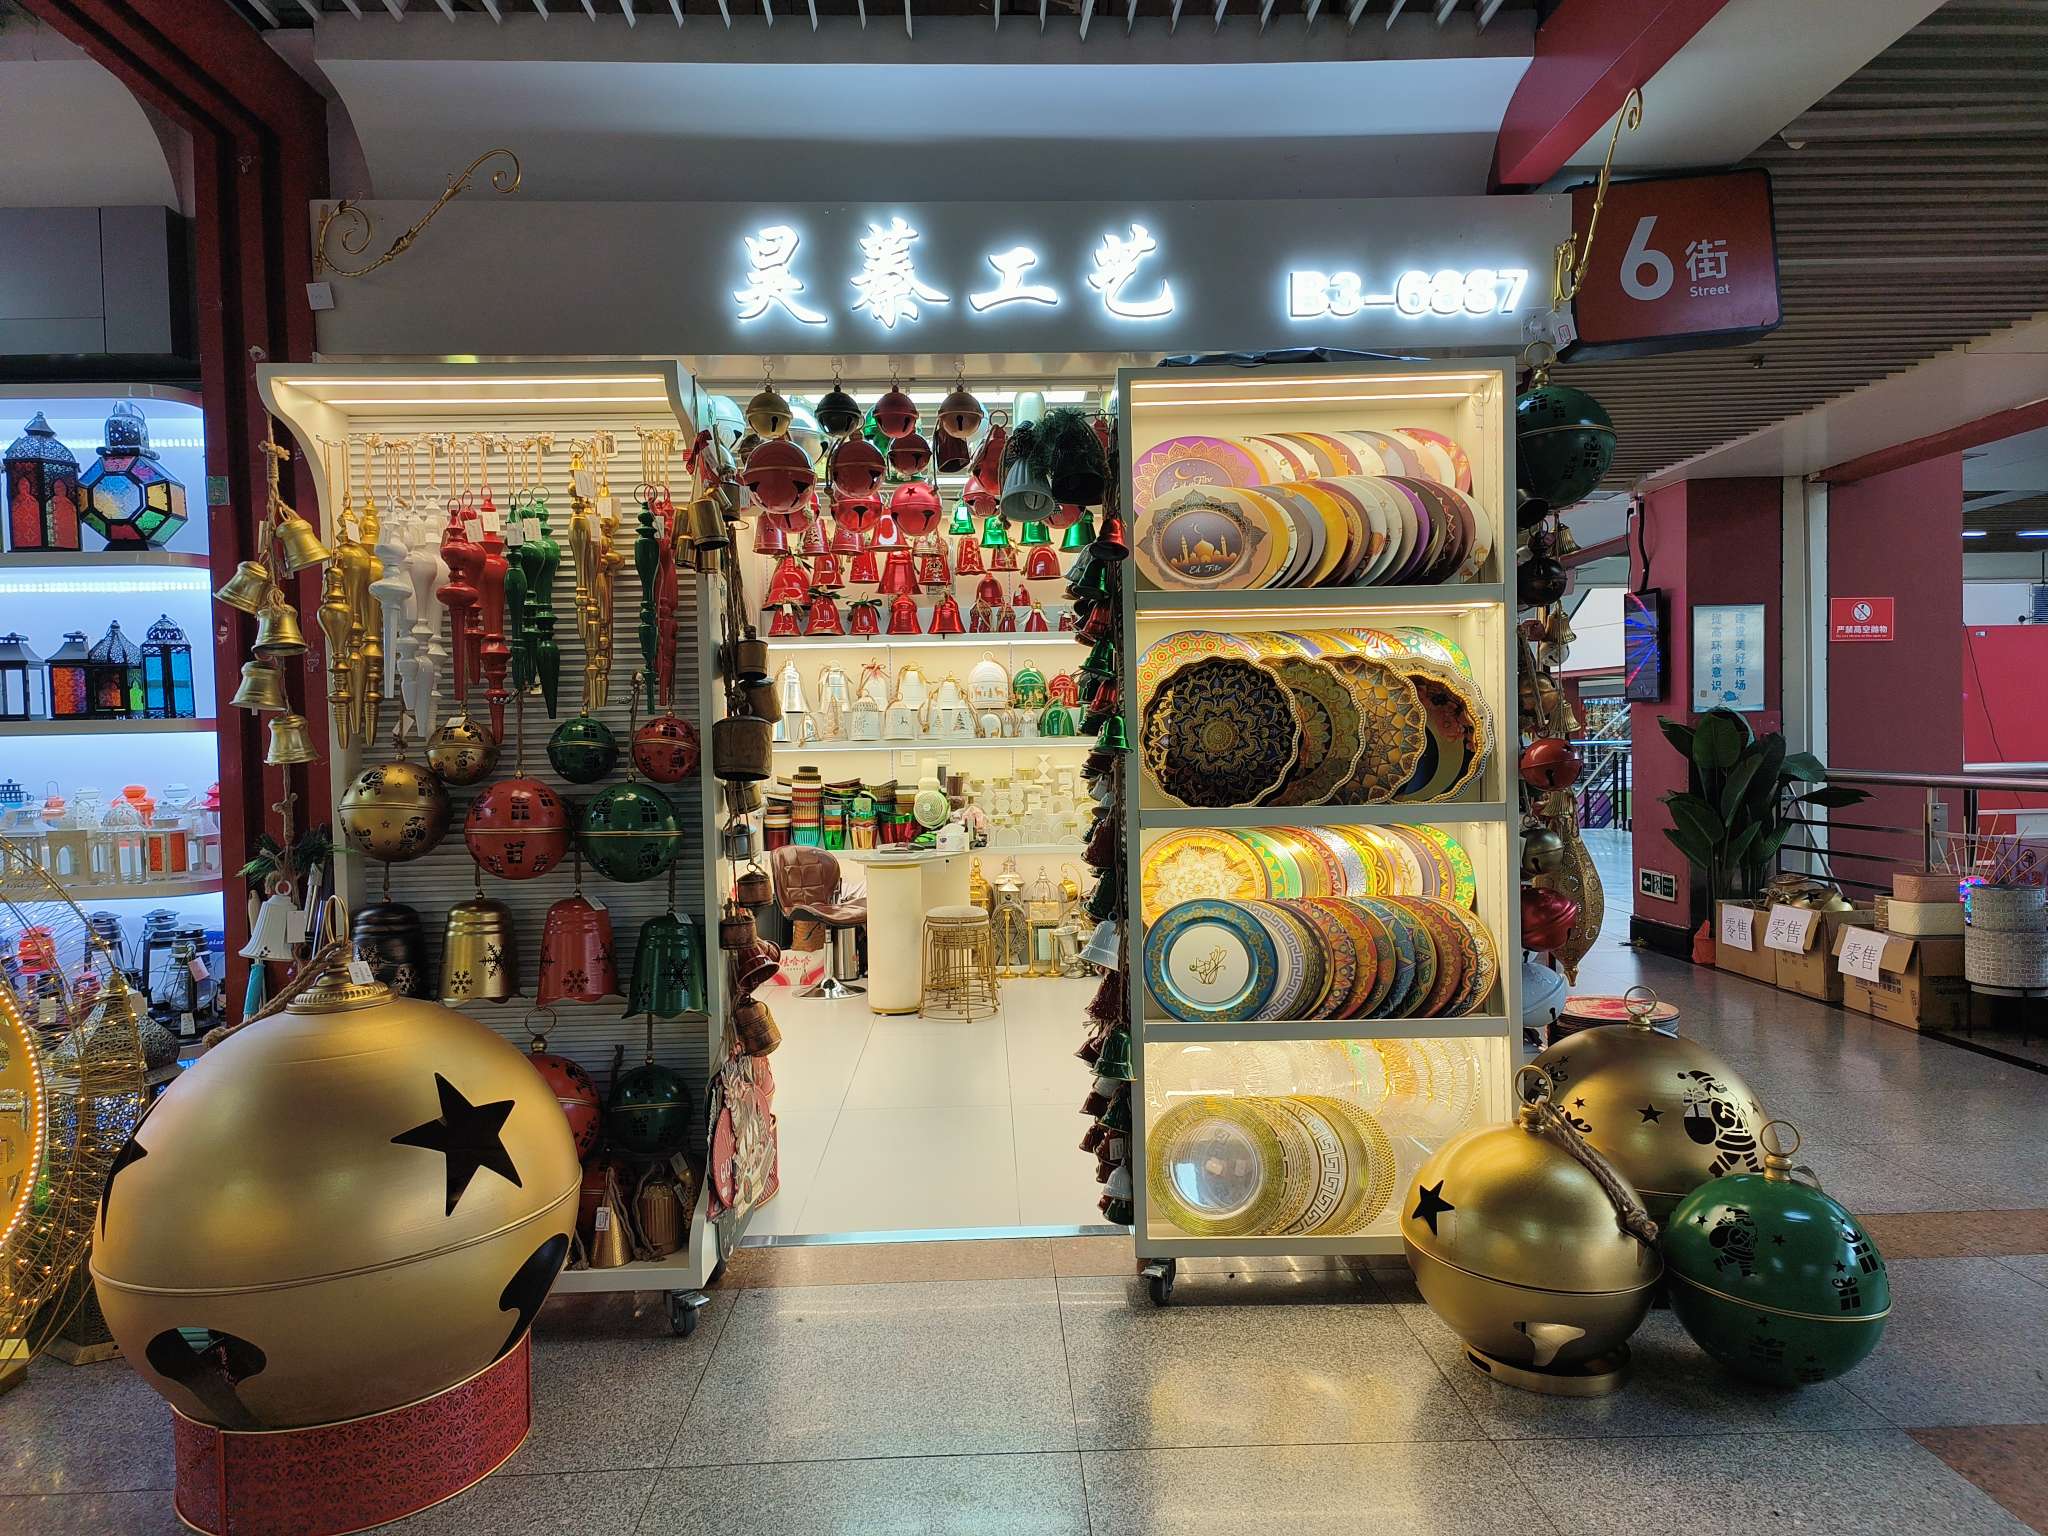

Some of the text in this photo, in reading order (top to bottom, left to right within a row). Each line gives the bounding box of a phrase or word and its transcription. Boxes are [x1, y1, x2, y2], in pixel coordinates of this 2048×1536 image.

[1619, 215, 1729, 301] 6 街
[1690, 284, 1731, 298] Street
[1836, 625, 1888, 634] 严禁高空抛物
[1725, 917, 1747, 941] 零售
[1770, 918, 1802, 944] 零售
[1845, 942, 1878, 970] 零售
